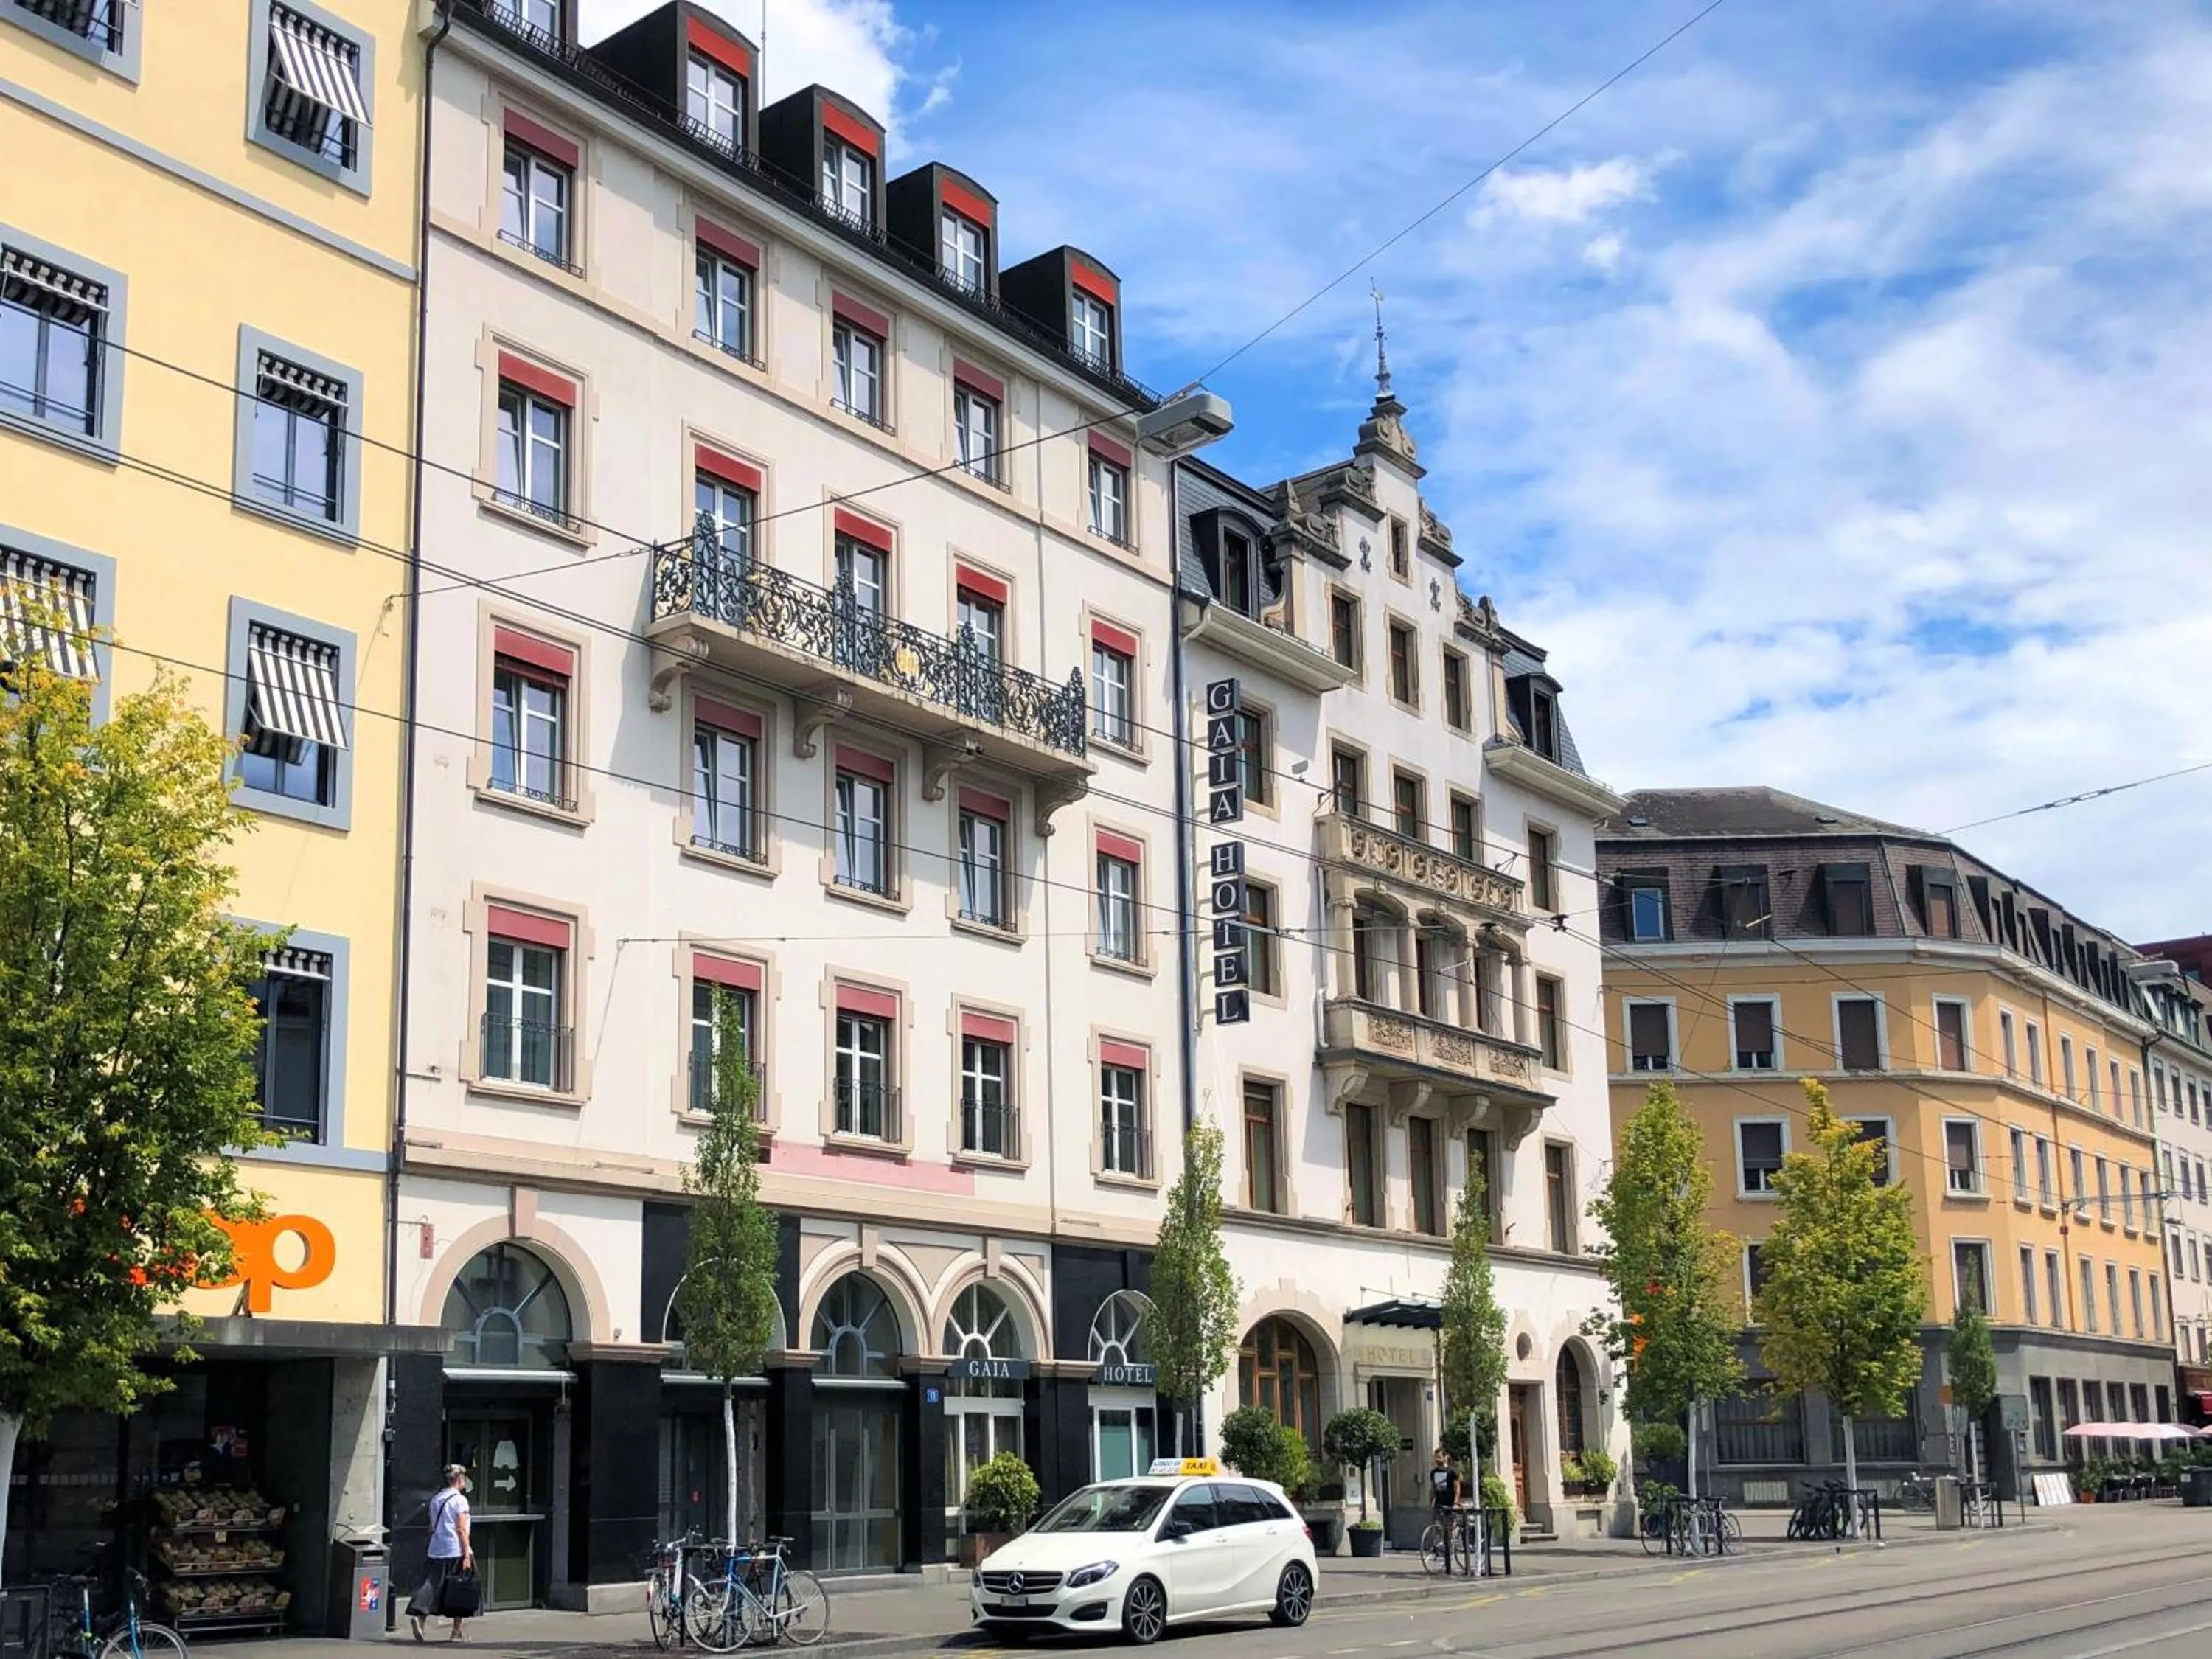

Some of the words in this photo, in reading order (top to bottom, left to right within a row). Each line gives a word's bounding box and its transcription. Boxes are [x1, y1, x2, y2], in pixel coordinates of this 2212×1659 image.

[1209, 683, 1235, 821] GAIA
[1214, 845, 1239, 1021] HOTEL
[968, 1360, 1010, 1377] GAIA
[1103, 1366, 1152, 1383] HOTEL
